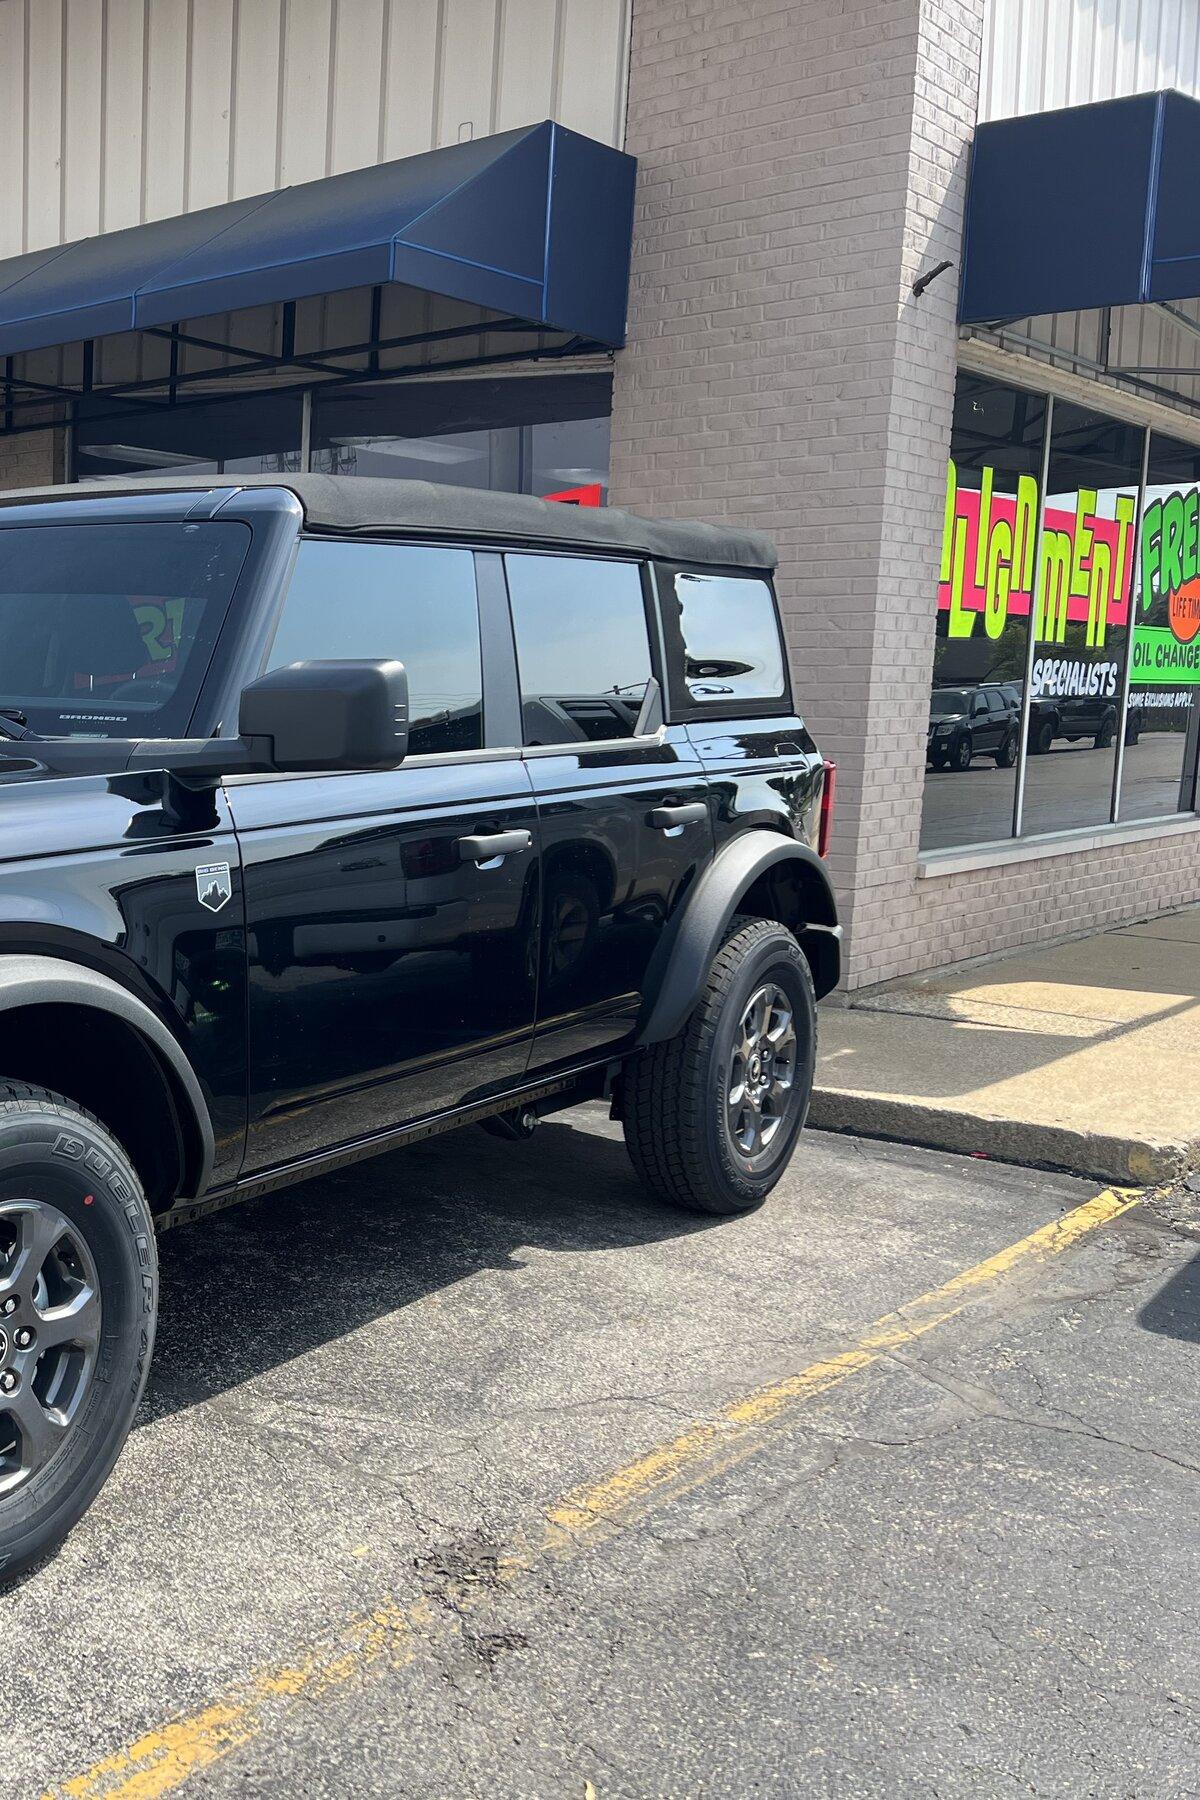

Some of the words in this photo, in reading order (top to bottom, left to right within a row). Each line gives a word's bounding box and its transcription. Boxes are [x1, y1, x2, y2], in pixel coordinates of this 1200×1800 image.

[1140, 489, 1200, 611] FRE
[1133, 642, 1152, 668] OIL
[1030, 658, 1118, 697] SPECIALISTS
[1128, 692, 1145, 708] SOME
[59, 714, 129, 722] BRONCO
[51, 1132, 155, 1314] DUELER
